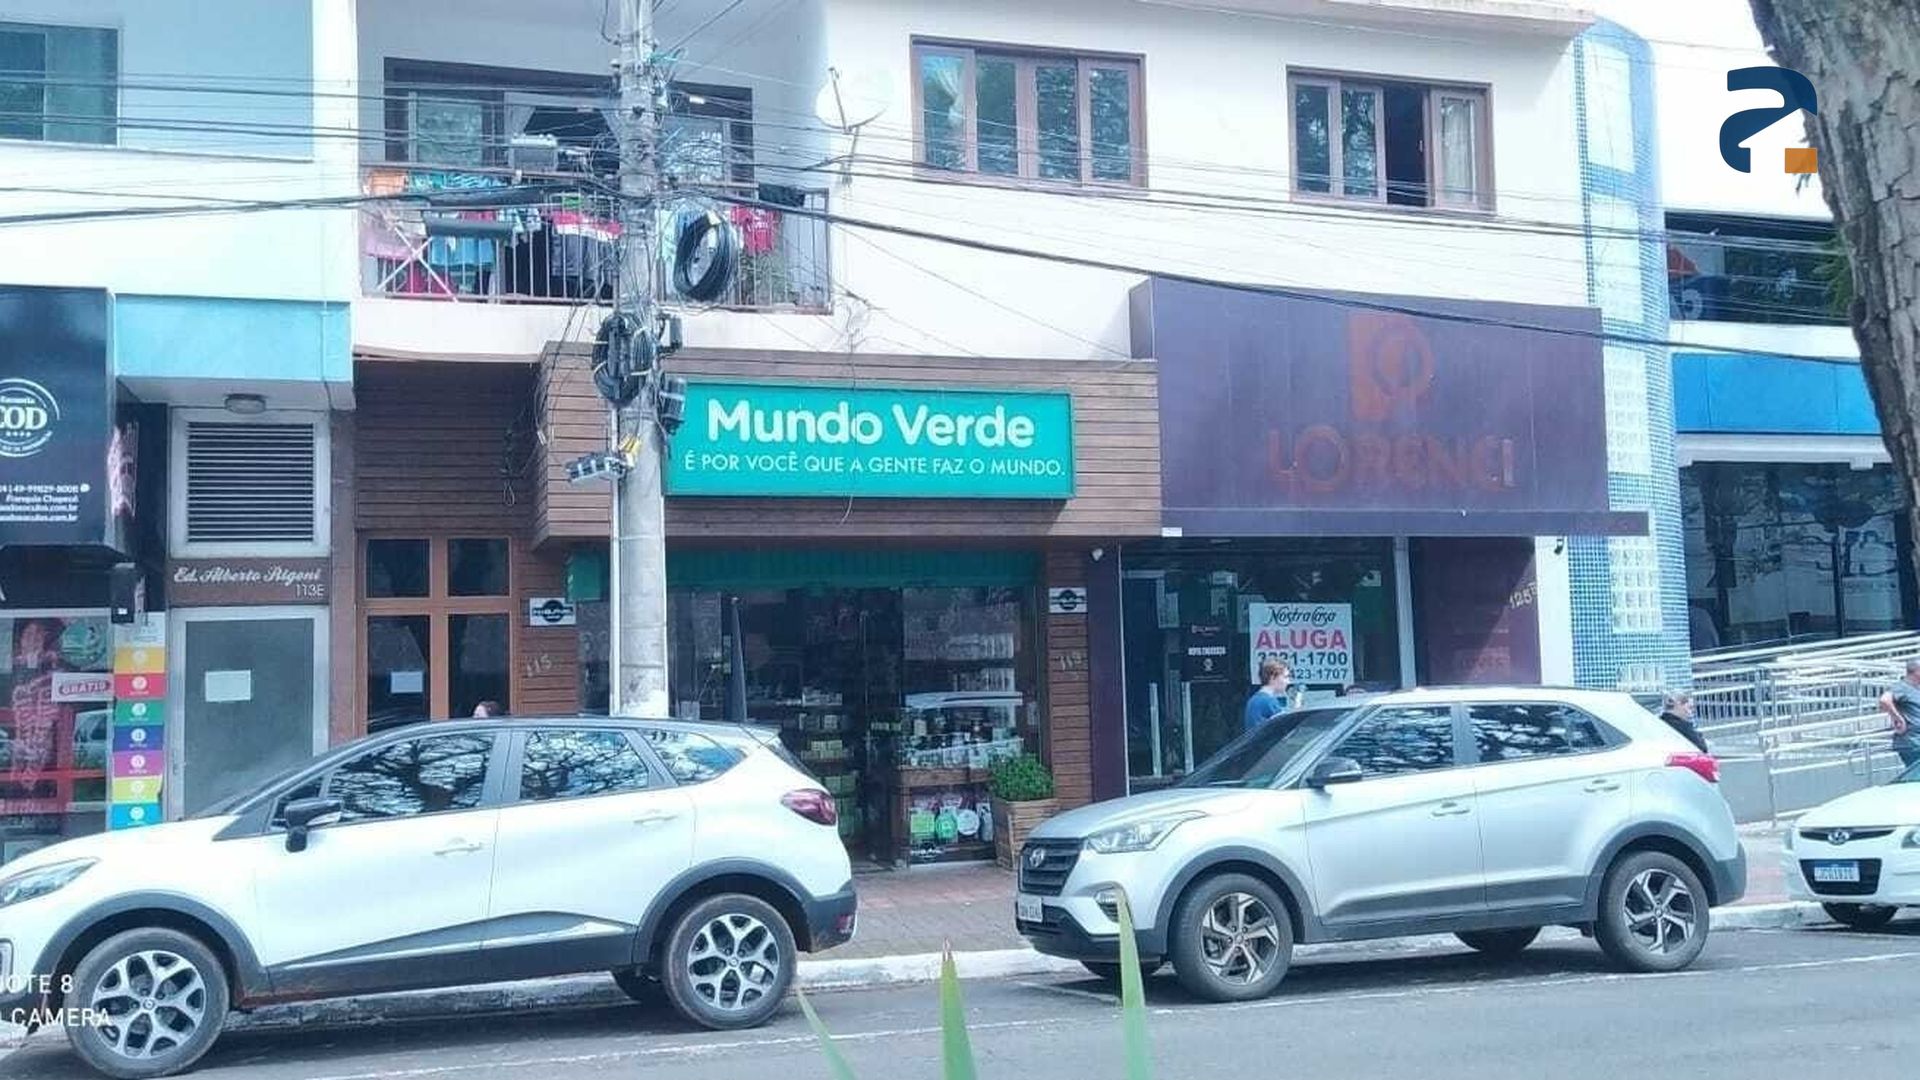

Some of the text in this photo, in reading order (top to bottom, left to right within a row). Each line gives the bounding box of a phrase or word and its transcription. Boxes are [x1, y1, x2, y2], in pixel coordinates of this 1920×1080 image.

[707, 398, 1035, 448] Mundo Verde
[684, 450, 1066, 477] É POR VOCÊ QUE A GENTE FAZ O MUNDO.
[200, 566, 261, 583] Alberto
[263, 566, 322, 586] Rigoni
[1256, 629, 1347, 650] ALUGA
